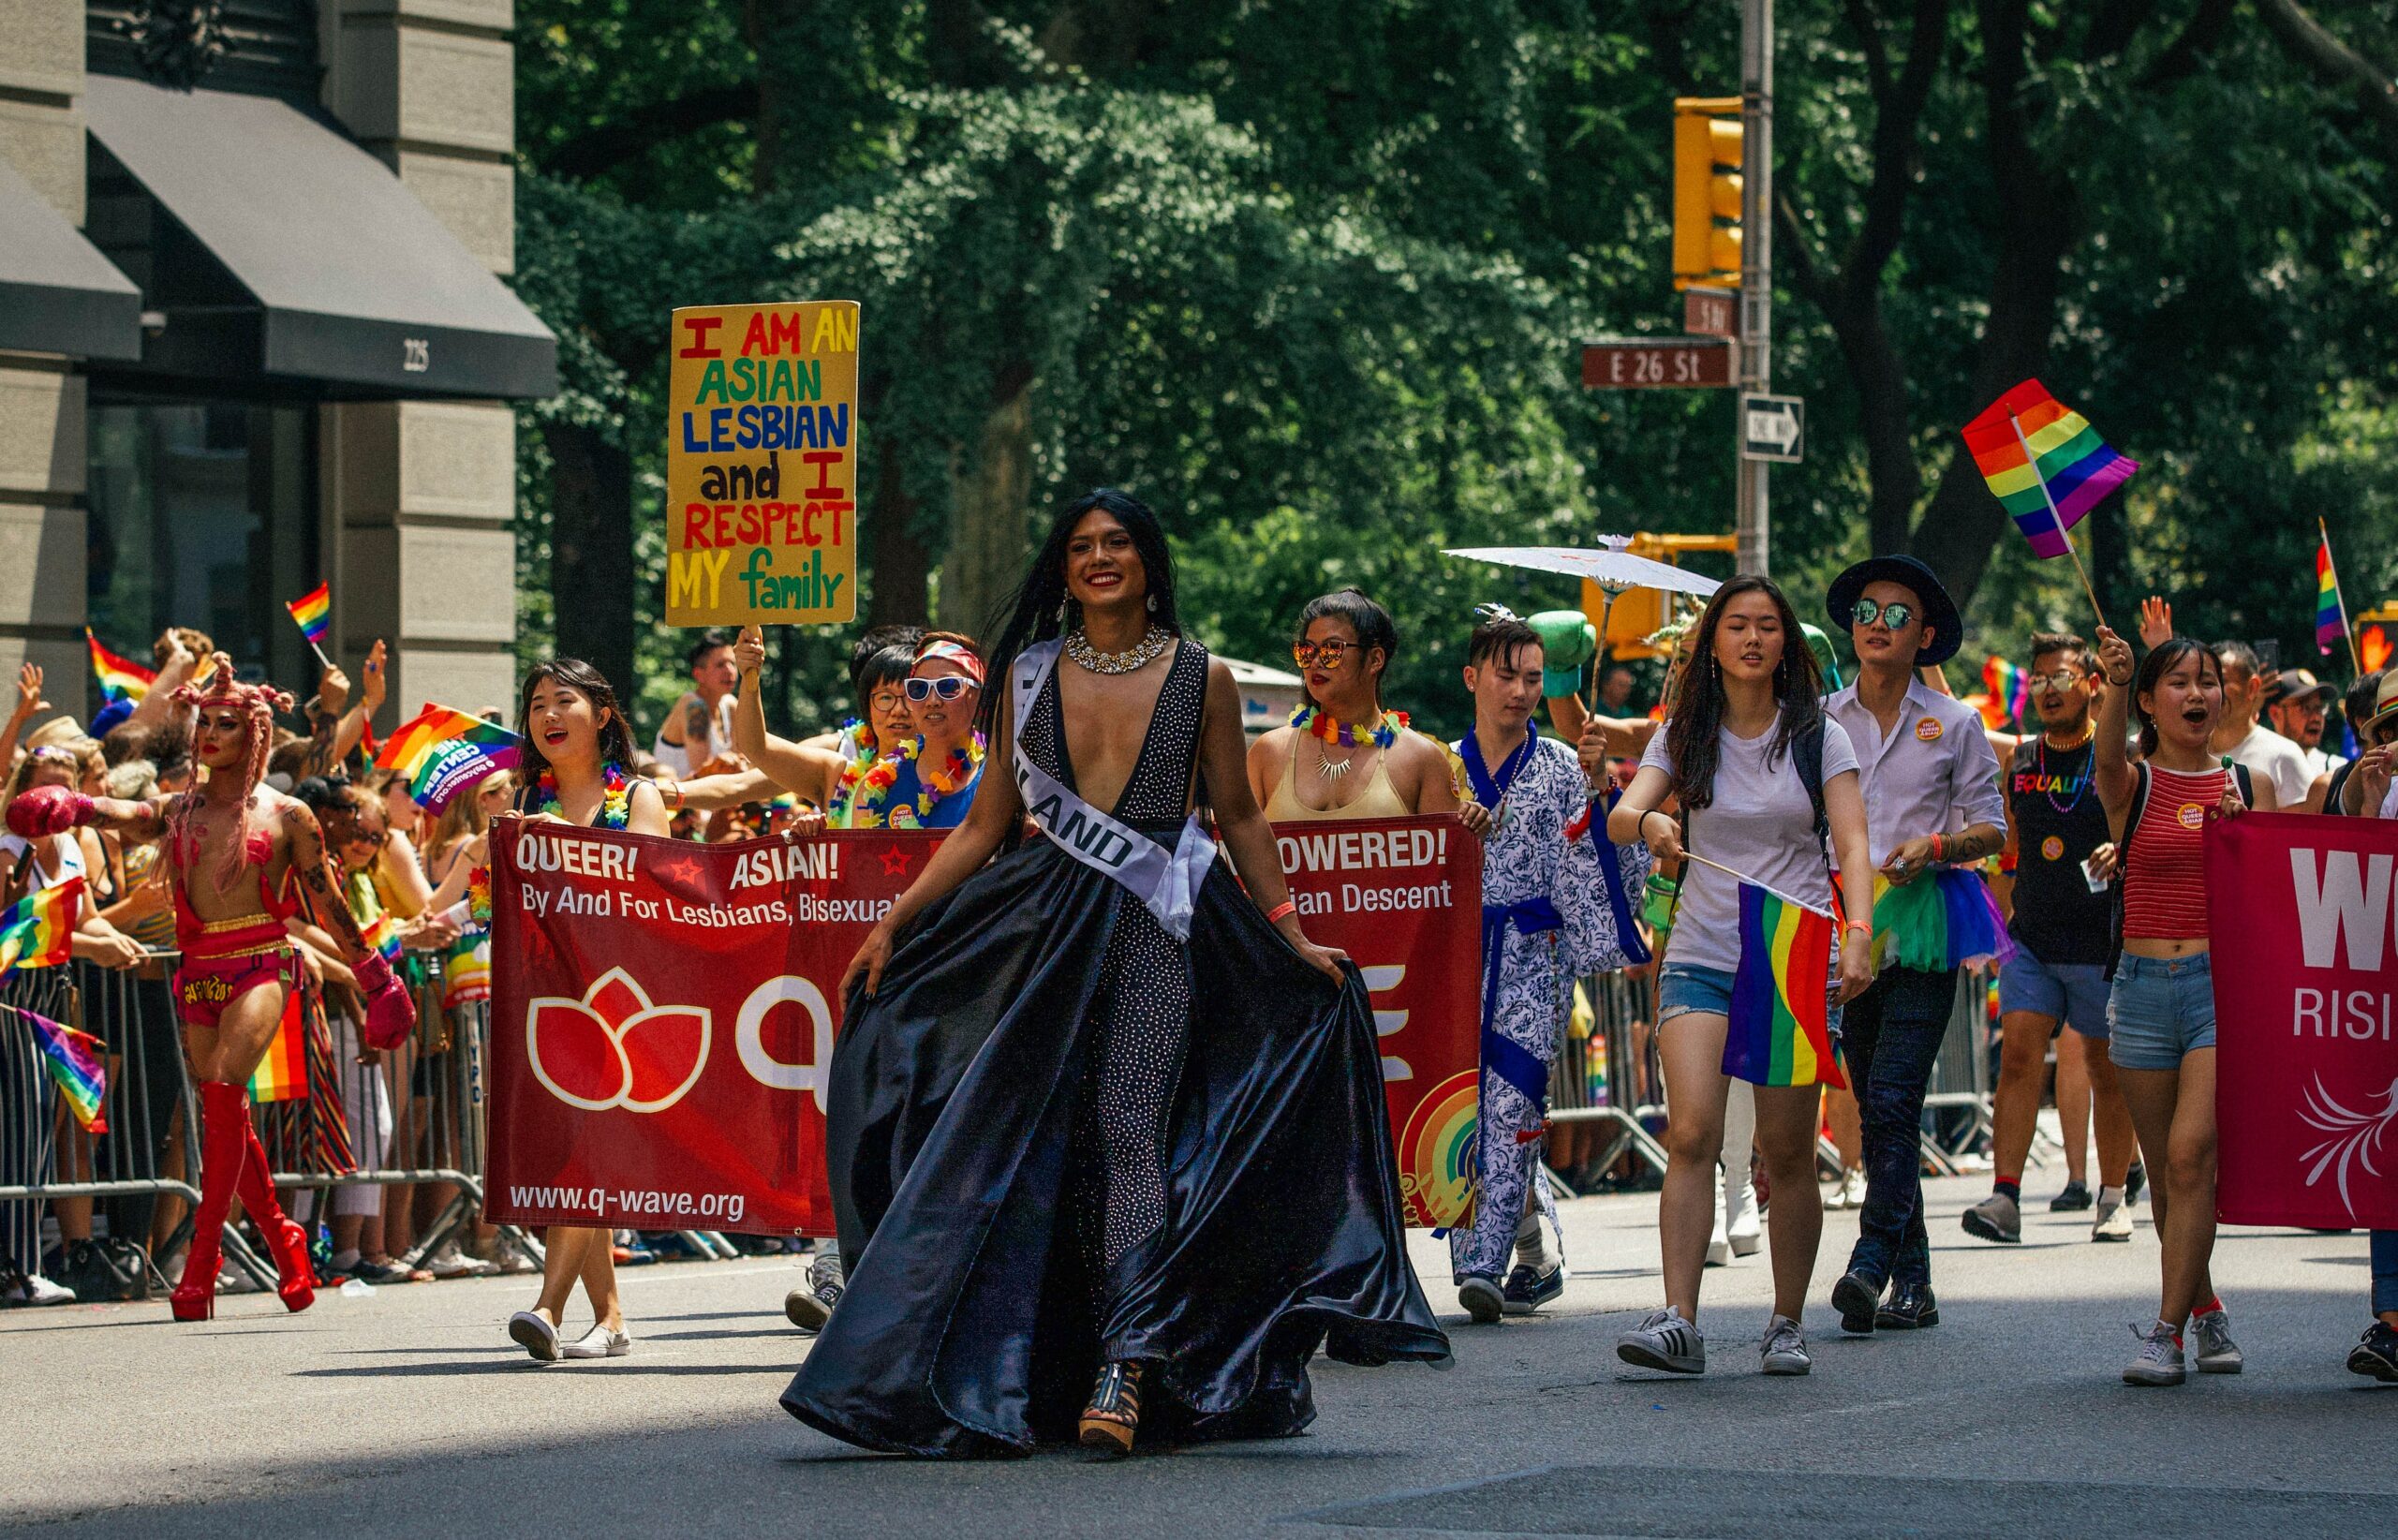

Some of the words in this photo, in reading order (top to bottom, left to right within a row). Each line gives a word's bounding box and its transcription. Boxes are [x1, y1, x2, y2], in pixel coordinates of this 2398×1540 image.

[680, 317, 722, 358] I
[741, 312, 801, 356] AM
[811, 307, 857, 353] AN
[694, 359, 822, 405] ASIAN
[1610, 351, 1625, 382] E
[1634, 351, 1665, 383] 26
[1674, 350, 1701, 382] St
[682, 403, 849, 452] LESBIAN
[701, 452, 780, 500] and
[803, 452, 845, 499] I
[683, 501, 854, 549] RESPECT
[670, 550, 730, 609] MY
[739, 547, 844, 609] family
[516, 834, 638, 881] QUEER!
[730, 843, 839, 890] ASIAN!
[1277, 828, 1446, 875] OWERED!
[522, 883, 547, 918] By
[555, 886, 611, 917] And
[620, 892, 659, 920] For
[665, 897, 793, 928] Lesbians,
[1289, 887, 1332, 915] ian
[1341, 879, 1452, 912] Descent
[510, 1186, 745, 1222] www.q-wave.org
